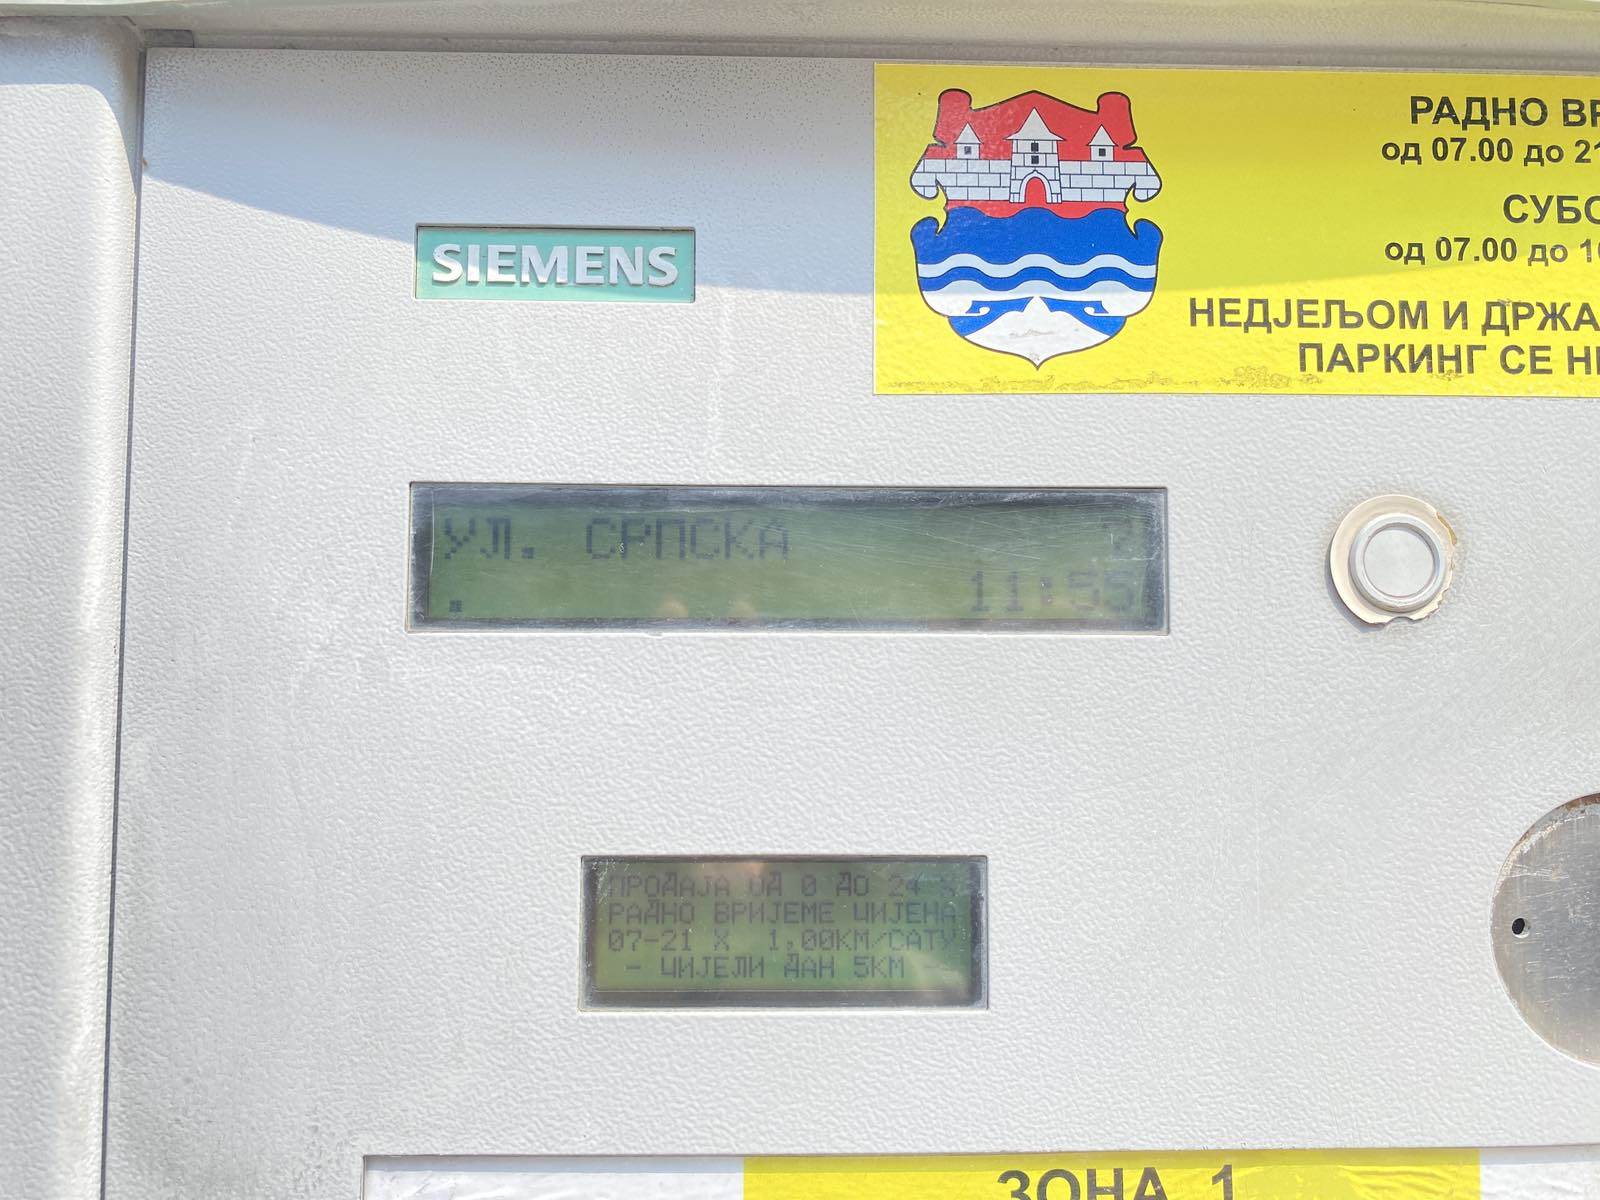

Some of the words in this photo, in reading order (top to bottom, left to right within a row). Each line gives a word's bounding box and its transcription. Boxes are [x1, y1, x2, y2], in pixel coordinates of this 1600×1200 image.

[1411, 96, 1548, 131] РАДНО
[1381, 141, 1422, 165] од
[1432, 137, 1513, 162] 07.00
[1524, 144, 1564, 166] до
[432, 243, 679, 287] SIEMENS
[1384, 242, 1425, 265] од
[1435, 236, 1517, 262] 07.00
[1528, 244, 1568, 267] до
[1580, 238, 1600, 263] 1
[1190, 297, 1428, 334] НЕДЈЕЉОМ
[1443, 301, 1468, 330] И
[1481, 300, 1600, 336] ДРЖА
[1298, 342, 1486, 374] ПАРКИНГ
[1500, 344, 1552, 375] СЕ
[1567, 345, 1600, 375] Н
[584, 517, 790, 561] СРПСКА
[969, 569, 1136, 613] 11:55
[608, 898, 695, 924] РАДНО
[713, 900, 835, 924] ВРИЈЕМЕ
[608, 928, 691, 952] 07-21
[784, 952, 835, 979] ДАН
[996, 1166, 1169, 1200] ЗОНА
[1210, 1164, 1234, 1200] 1
